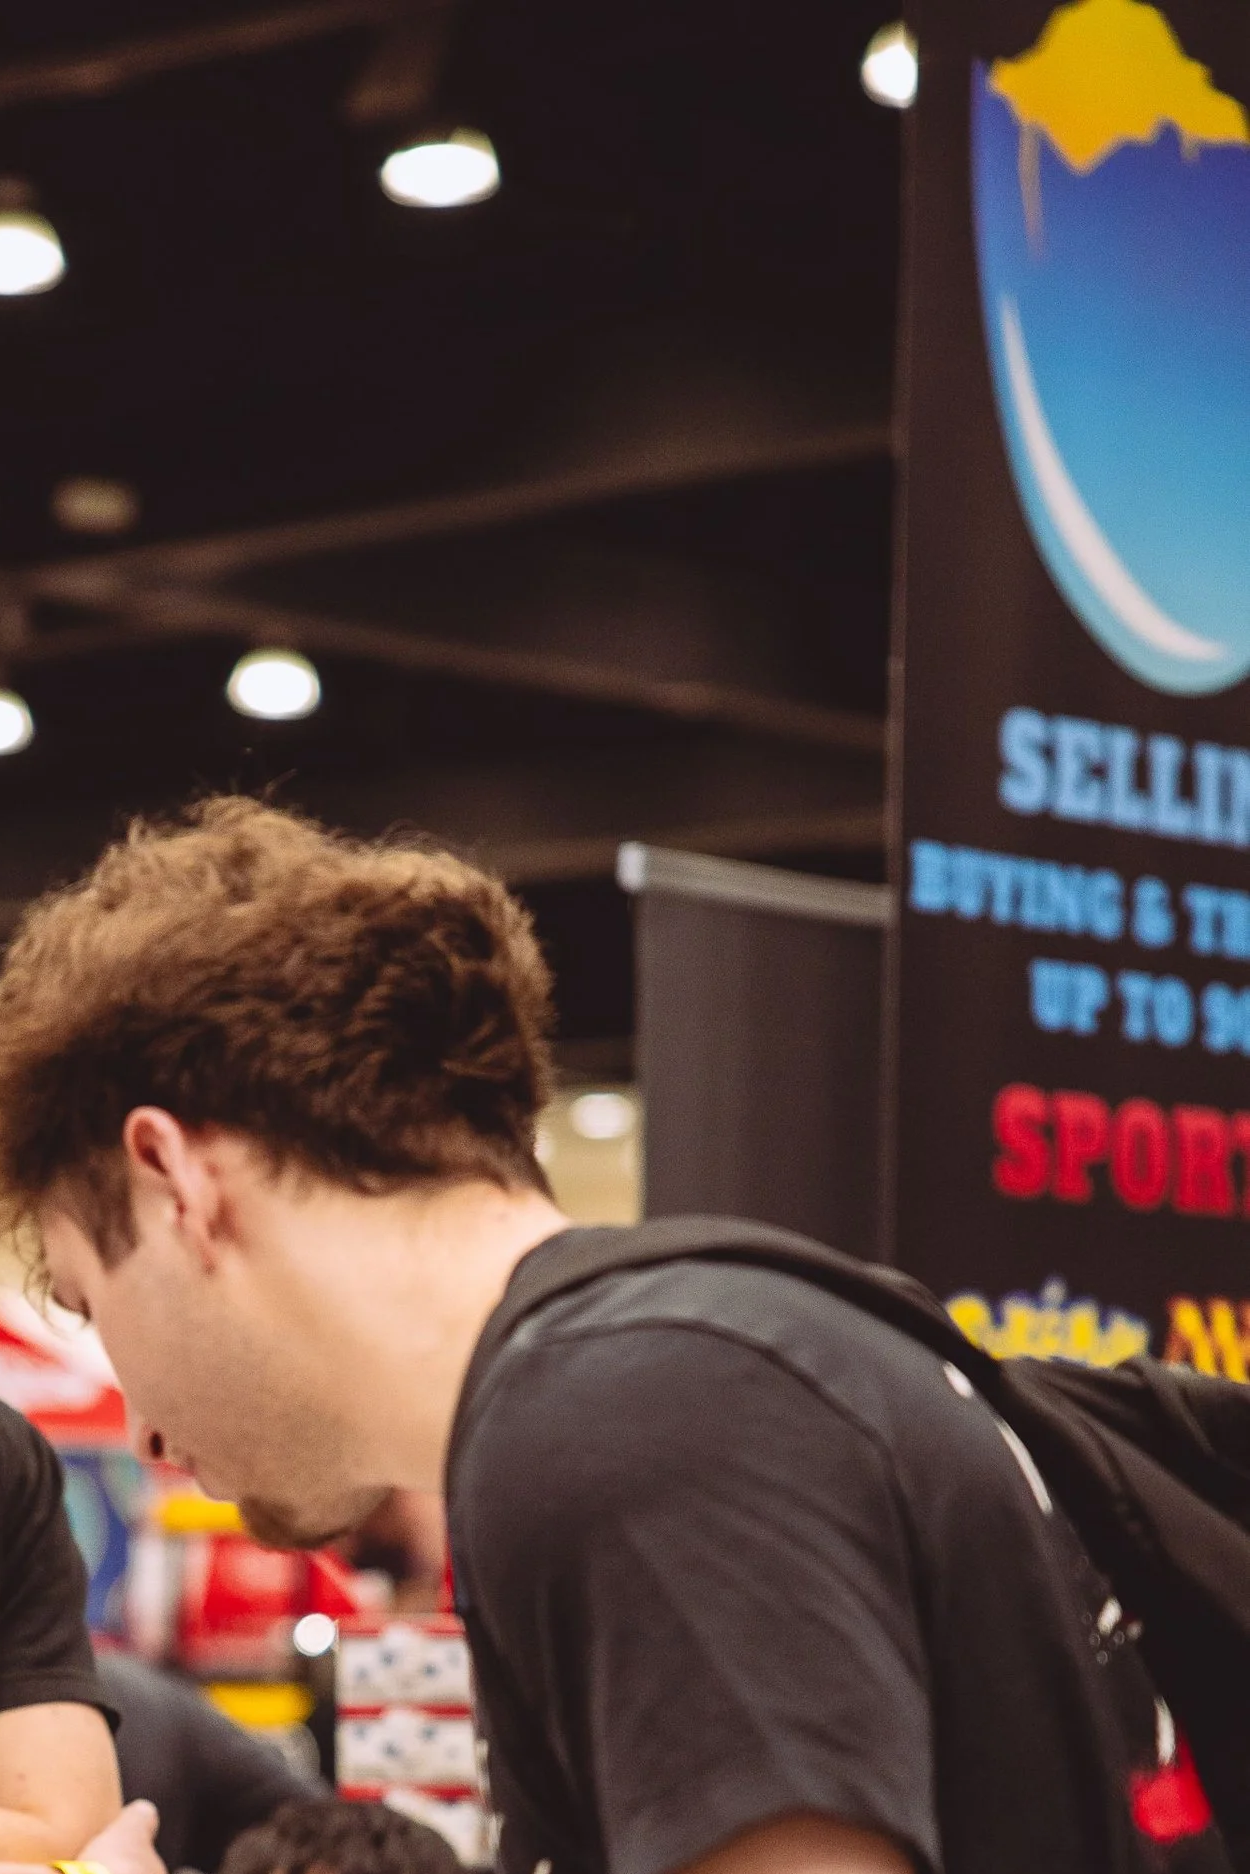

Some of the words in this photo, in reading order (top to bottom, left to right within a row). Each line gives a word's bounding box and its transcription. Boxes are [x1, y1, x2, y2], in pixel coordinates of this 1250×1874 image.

[909, 842, 1124, 942] BUYING
[1131, 875, 1177, 949] &
[1029, 956, 1111, 1036] UP
[1115, 970, 1194, 1047] TO
